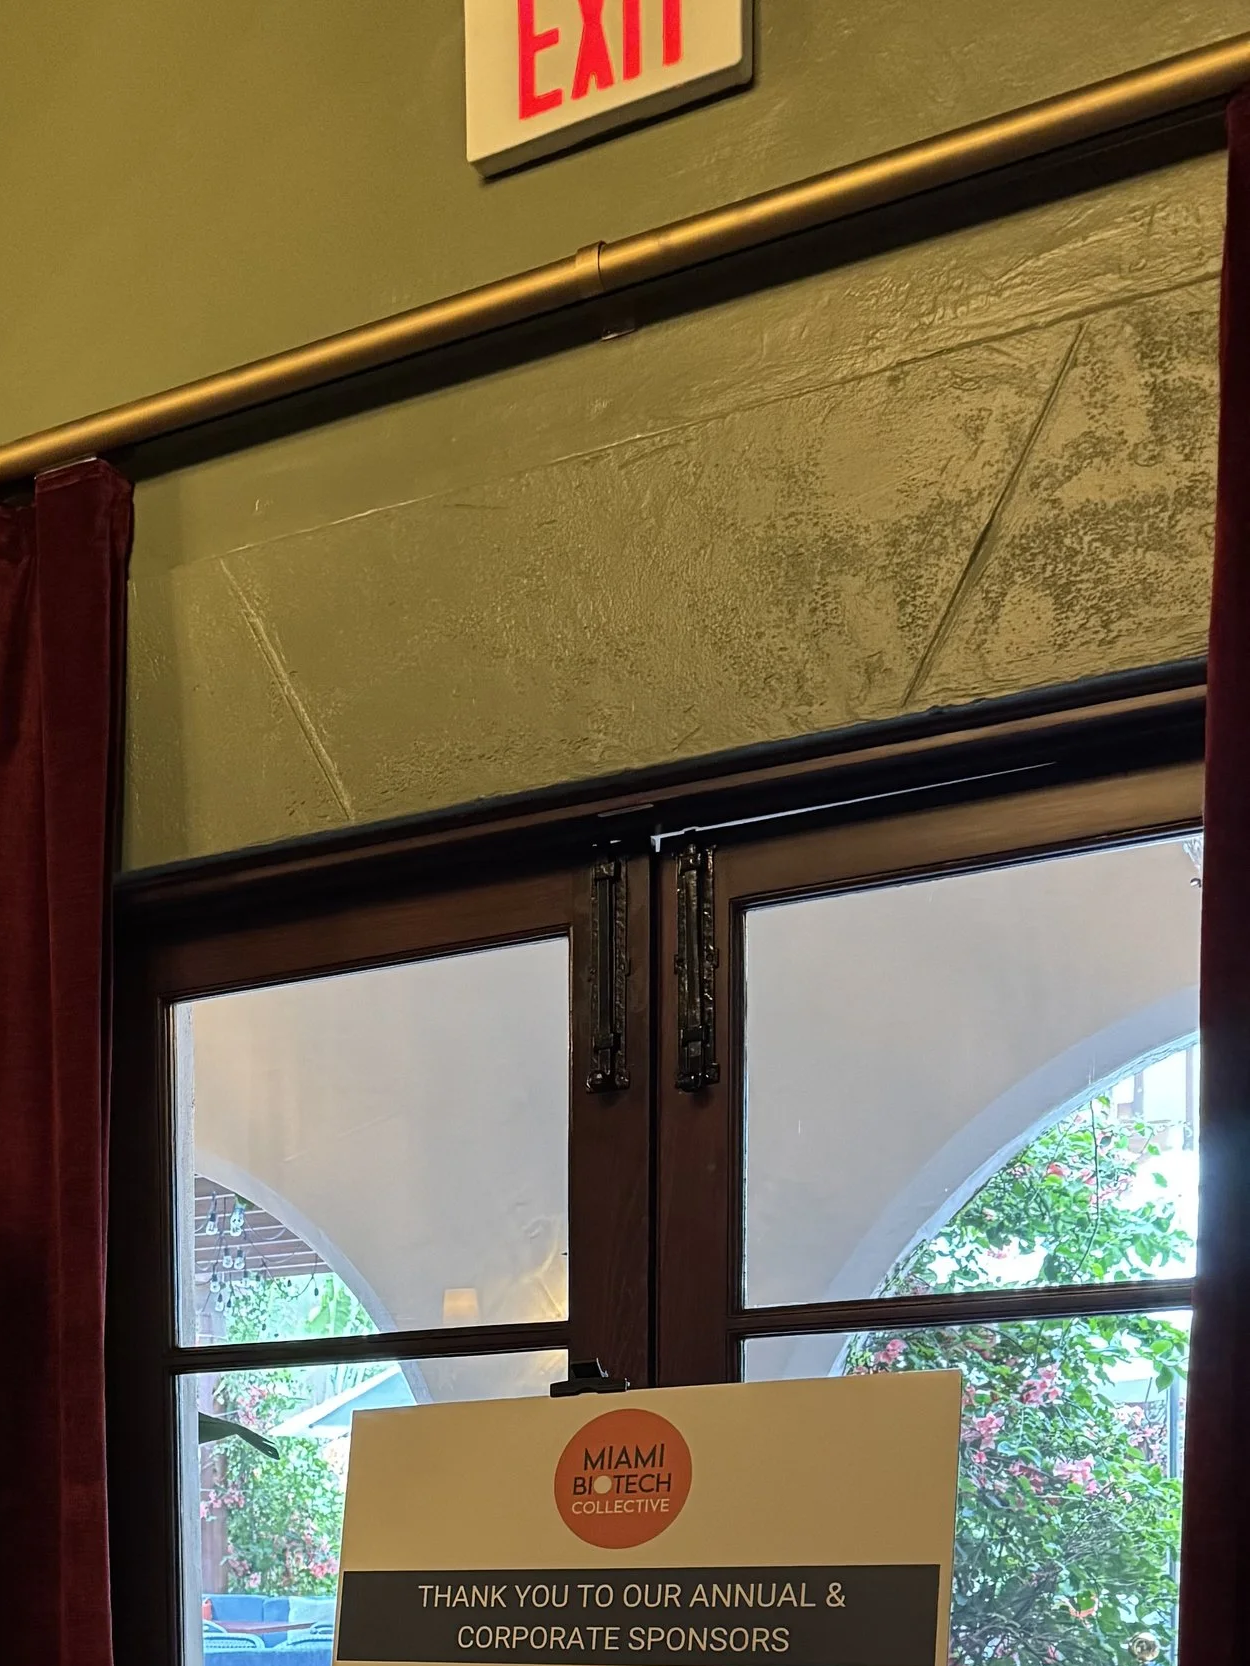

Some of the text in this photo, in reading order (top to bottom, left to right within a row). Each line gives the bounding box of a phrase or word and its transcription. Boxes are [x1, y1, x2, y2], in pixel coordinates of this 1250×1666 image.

[584, 1443, 665, 1471] MIAMI
[573, 1473, 672, 1495] BIOTECH
[571, 1498, 670, 1515] COLLECTIVE
[418, 1582, 847, 1608] THANK YOU TO OUR ANNUAL &
[457, 1626, 791, 1652] CORPORATE SPONSORS
